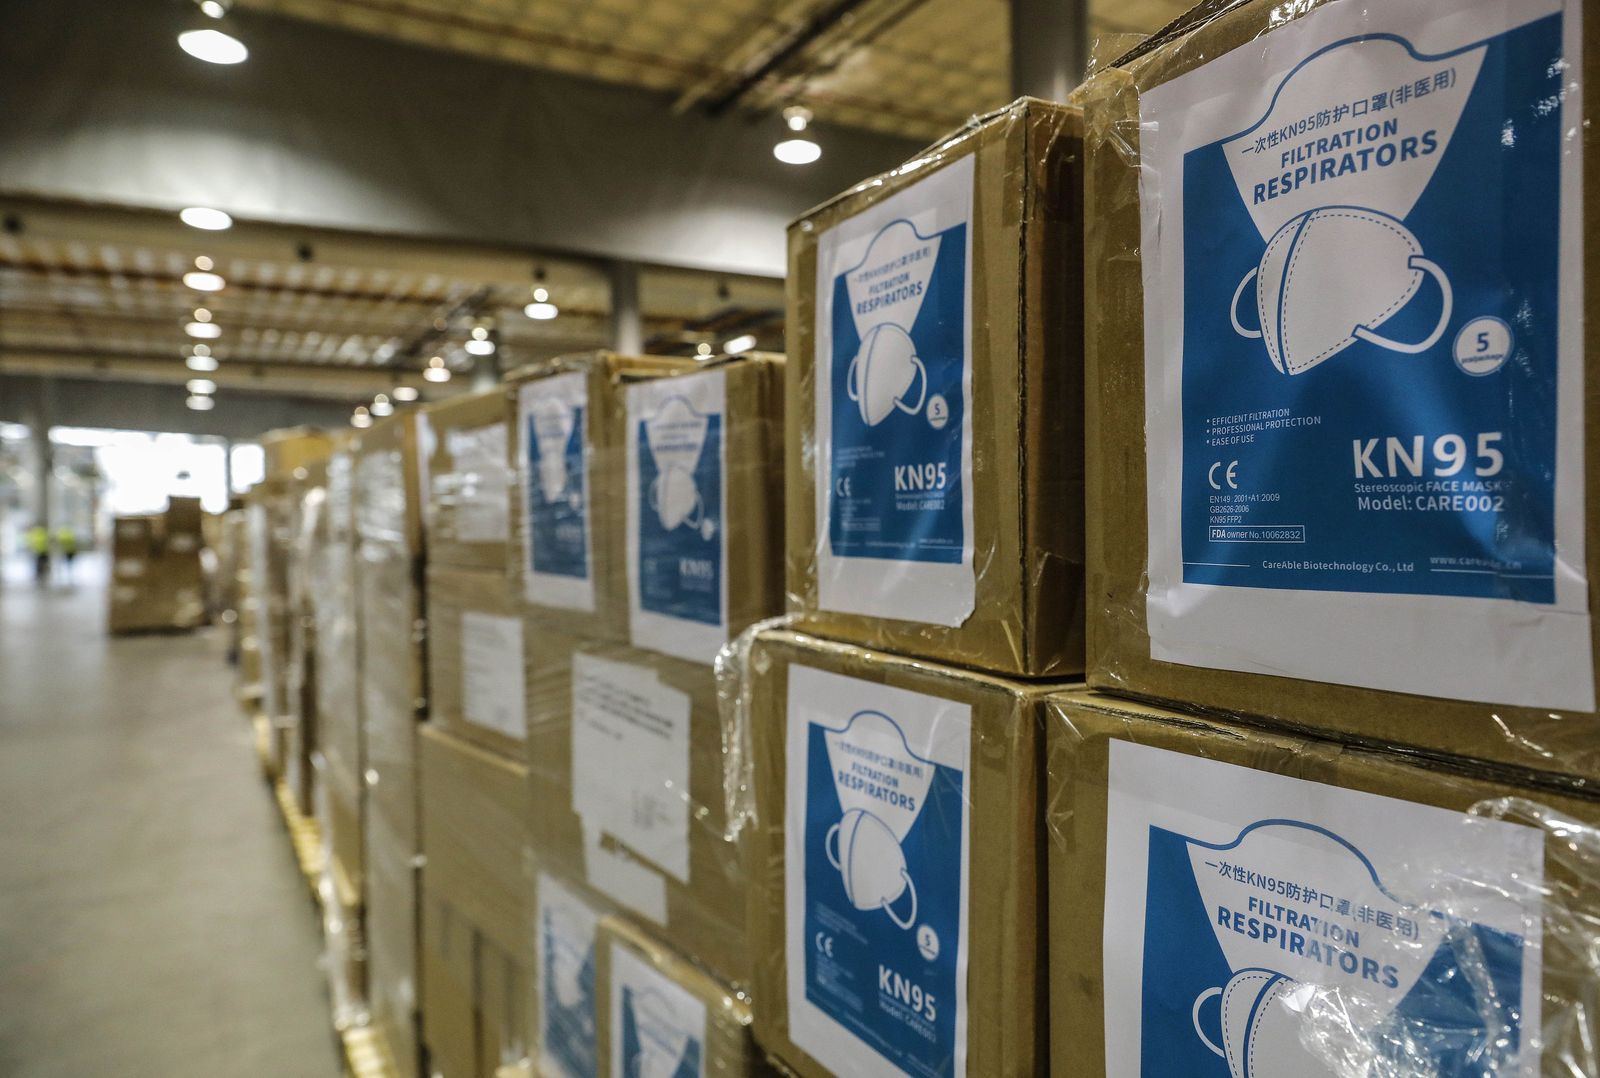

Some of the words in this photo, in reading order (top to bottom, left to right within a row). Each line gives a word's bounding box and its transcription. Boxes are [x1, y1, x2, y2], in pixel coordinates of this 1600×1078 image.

[1241, 67, 1457, 155] 一次性KN95防护口罩(非医用)
[1281, 118, 1398, 169] FILTRATION
[1253, 129, 1438, 205] RESPIRATORS
[868, 271, 911, 295] FILTRATION
[856, 281, 923, 315] RESPIRATORS
[1476, 332, 1489, 352] 5
[935, 403, 941, 416] 5
[1211, 413, 1248, 426] EFFICIENT
[1248, 408, 1290, 421] FILTRATION
[1211, 422, 1264, 436] PROFESSIONAL
[1265, 416, 1321, 430] PROTECTION
[1211, 437, 1230, 447] EASE
[1230, 435, 1240, 445] OF
[1241, 434, 1255, 444] USE
[1353, 431, 1504, 478] KN95
[895, 462, 946, 491] KN95
[1208, 460, 1239, 490] CE
[1354, 482, 1423, 494] Stereoscopic
[1426, 481, 1459, 492] FACE
[1209, 505, 1250, 513] GB2626-2006
[1358, 495, 1413, 511] Model:
[1415, 495, 1504, 512] CARE002
[1209, 516, 1226, 524] KN95
[1226, 515, 1242, 524] FFP2
[1211, 529, 1226, 539] FDA
[1226, 531, 1248, 539] owner
[1262, 560, 1302, 570] CareAble
[1303, 561, 1374, 573] Biotechnology
[1397, 562, 1415, 572] Ltd
[852, 761, 899, 788] FILTRATION
[838, 771, 915, 812] RESPIRATORS
[1248, 896, 1360, 948] FILTRATION
[1218, 905, 1399, 989] RESPIRATORS
[879, 964, 937, 1022] KN95
